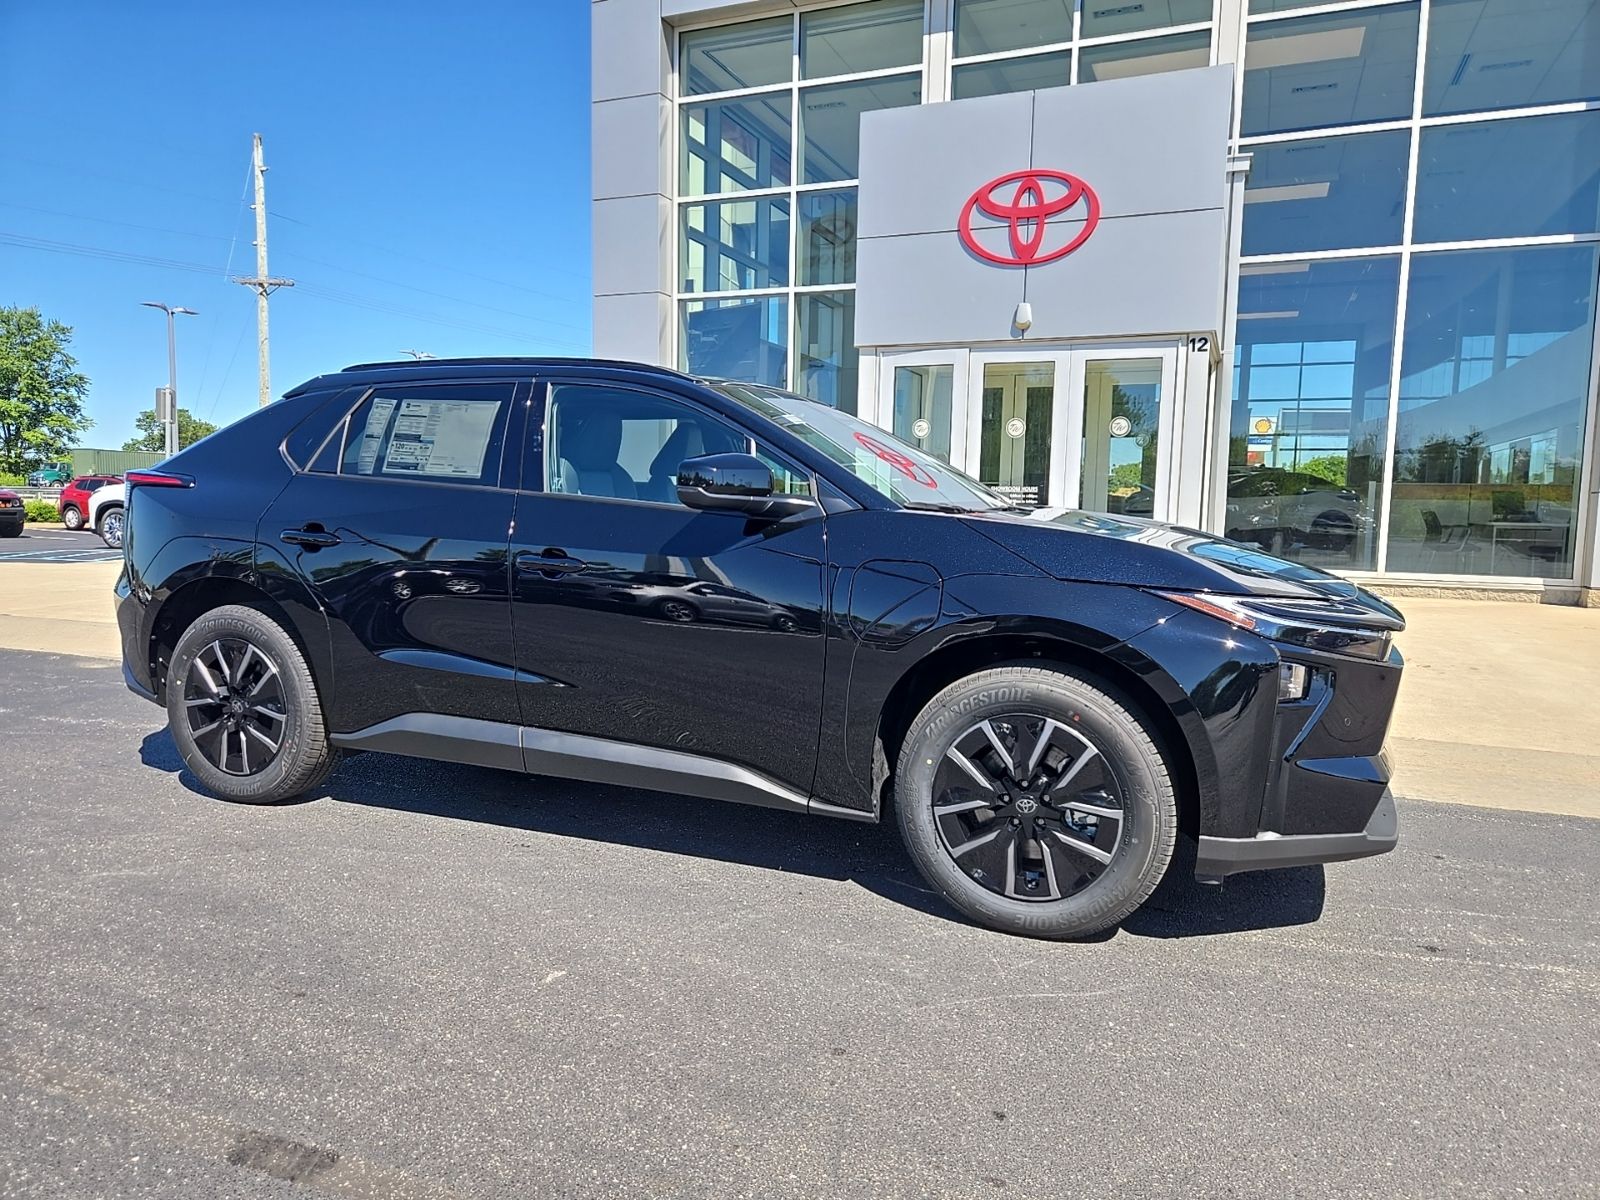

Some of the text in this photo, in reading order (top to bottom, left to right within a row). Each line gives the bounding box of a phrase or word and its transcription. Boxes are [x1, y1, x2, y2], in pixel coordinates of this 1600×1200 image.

[1190, 337, 1208, 352] 12
[200, 619, 267, 641] BRIDGESTONE
[925, 686, 1034, 740] BRIDGESTONE
[1013, 882, 1130, 931] BRIDGESTONE
